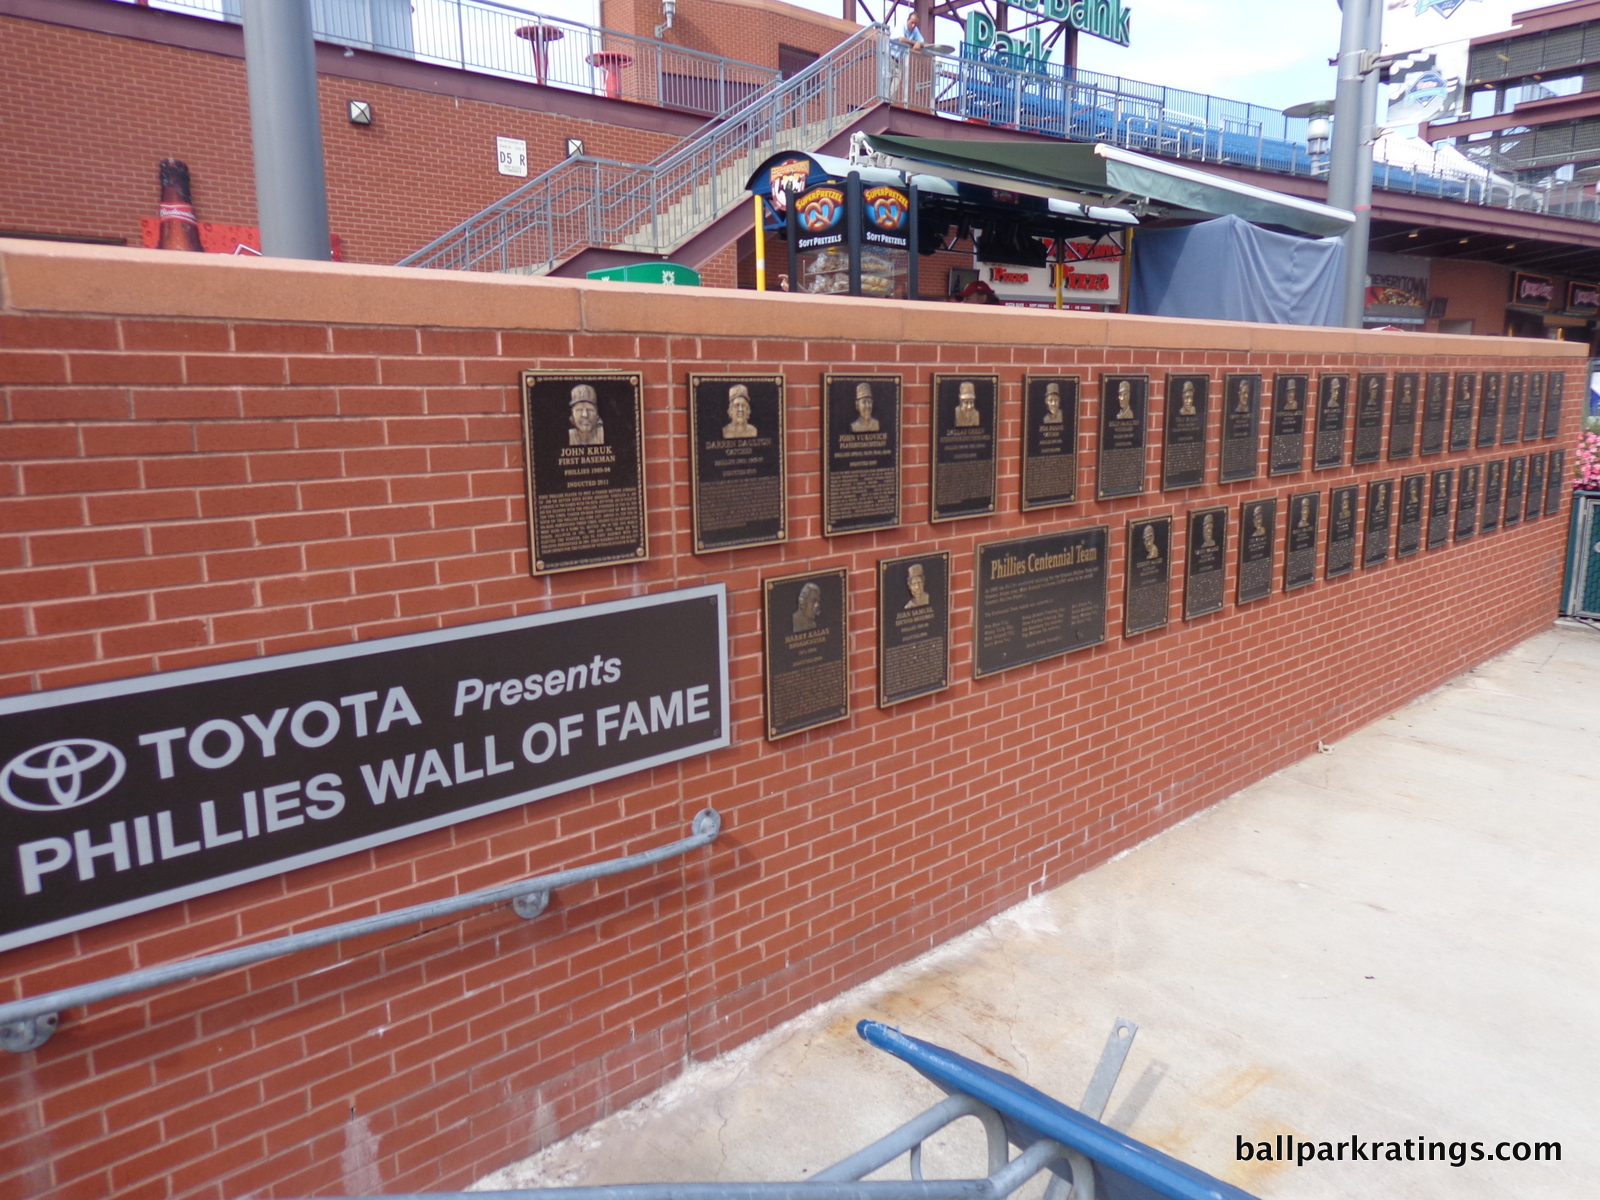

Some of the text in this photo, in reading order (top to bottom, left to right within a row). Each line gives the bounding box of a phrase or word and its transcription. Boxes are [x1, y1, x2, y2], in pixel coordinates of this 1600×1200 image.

[967, 10, 1052, 77] Park
[500, 151, 526, 166] D5 R
[799, 235, 842, 248] SOFT PRETZELS
[867, 232, 906, 246] SOFT PRETZELS
[991, 267, 1029, 283] Pizza
[1052, 264, 1110, 290] Pizza
[561, 446, 612, 457] JOHN KRUK
[558, 455, 616, 466] FIRST BASEMAN
[991, 545, 1098, 579] Phillies Centennial Team
[140, 655, 622, 779] TOYOTA Presents
[18, 772, 346, 895] PHILLIES
[360, 734, 514, 805] WALL
[522, 714, 584, 763] OF
[596, 684, 711, 746] FAME
